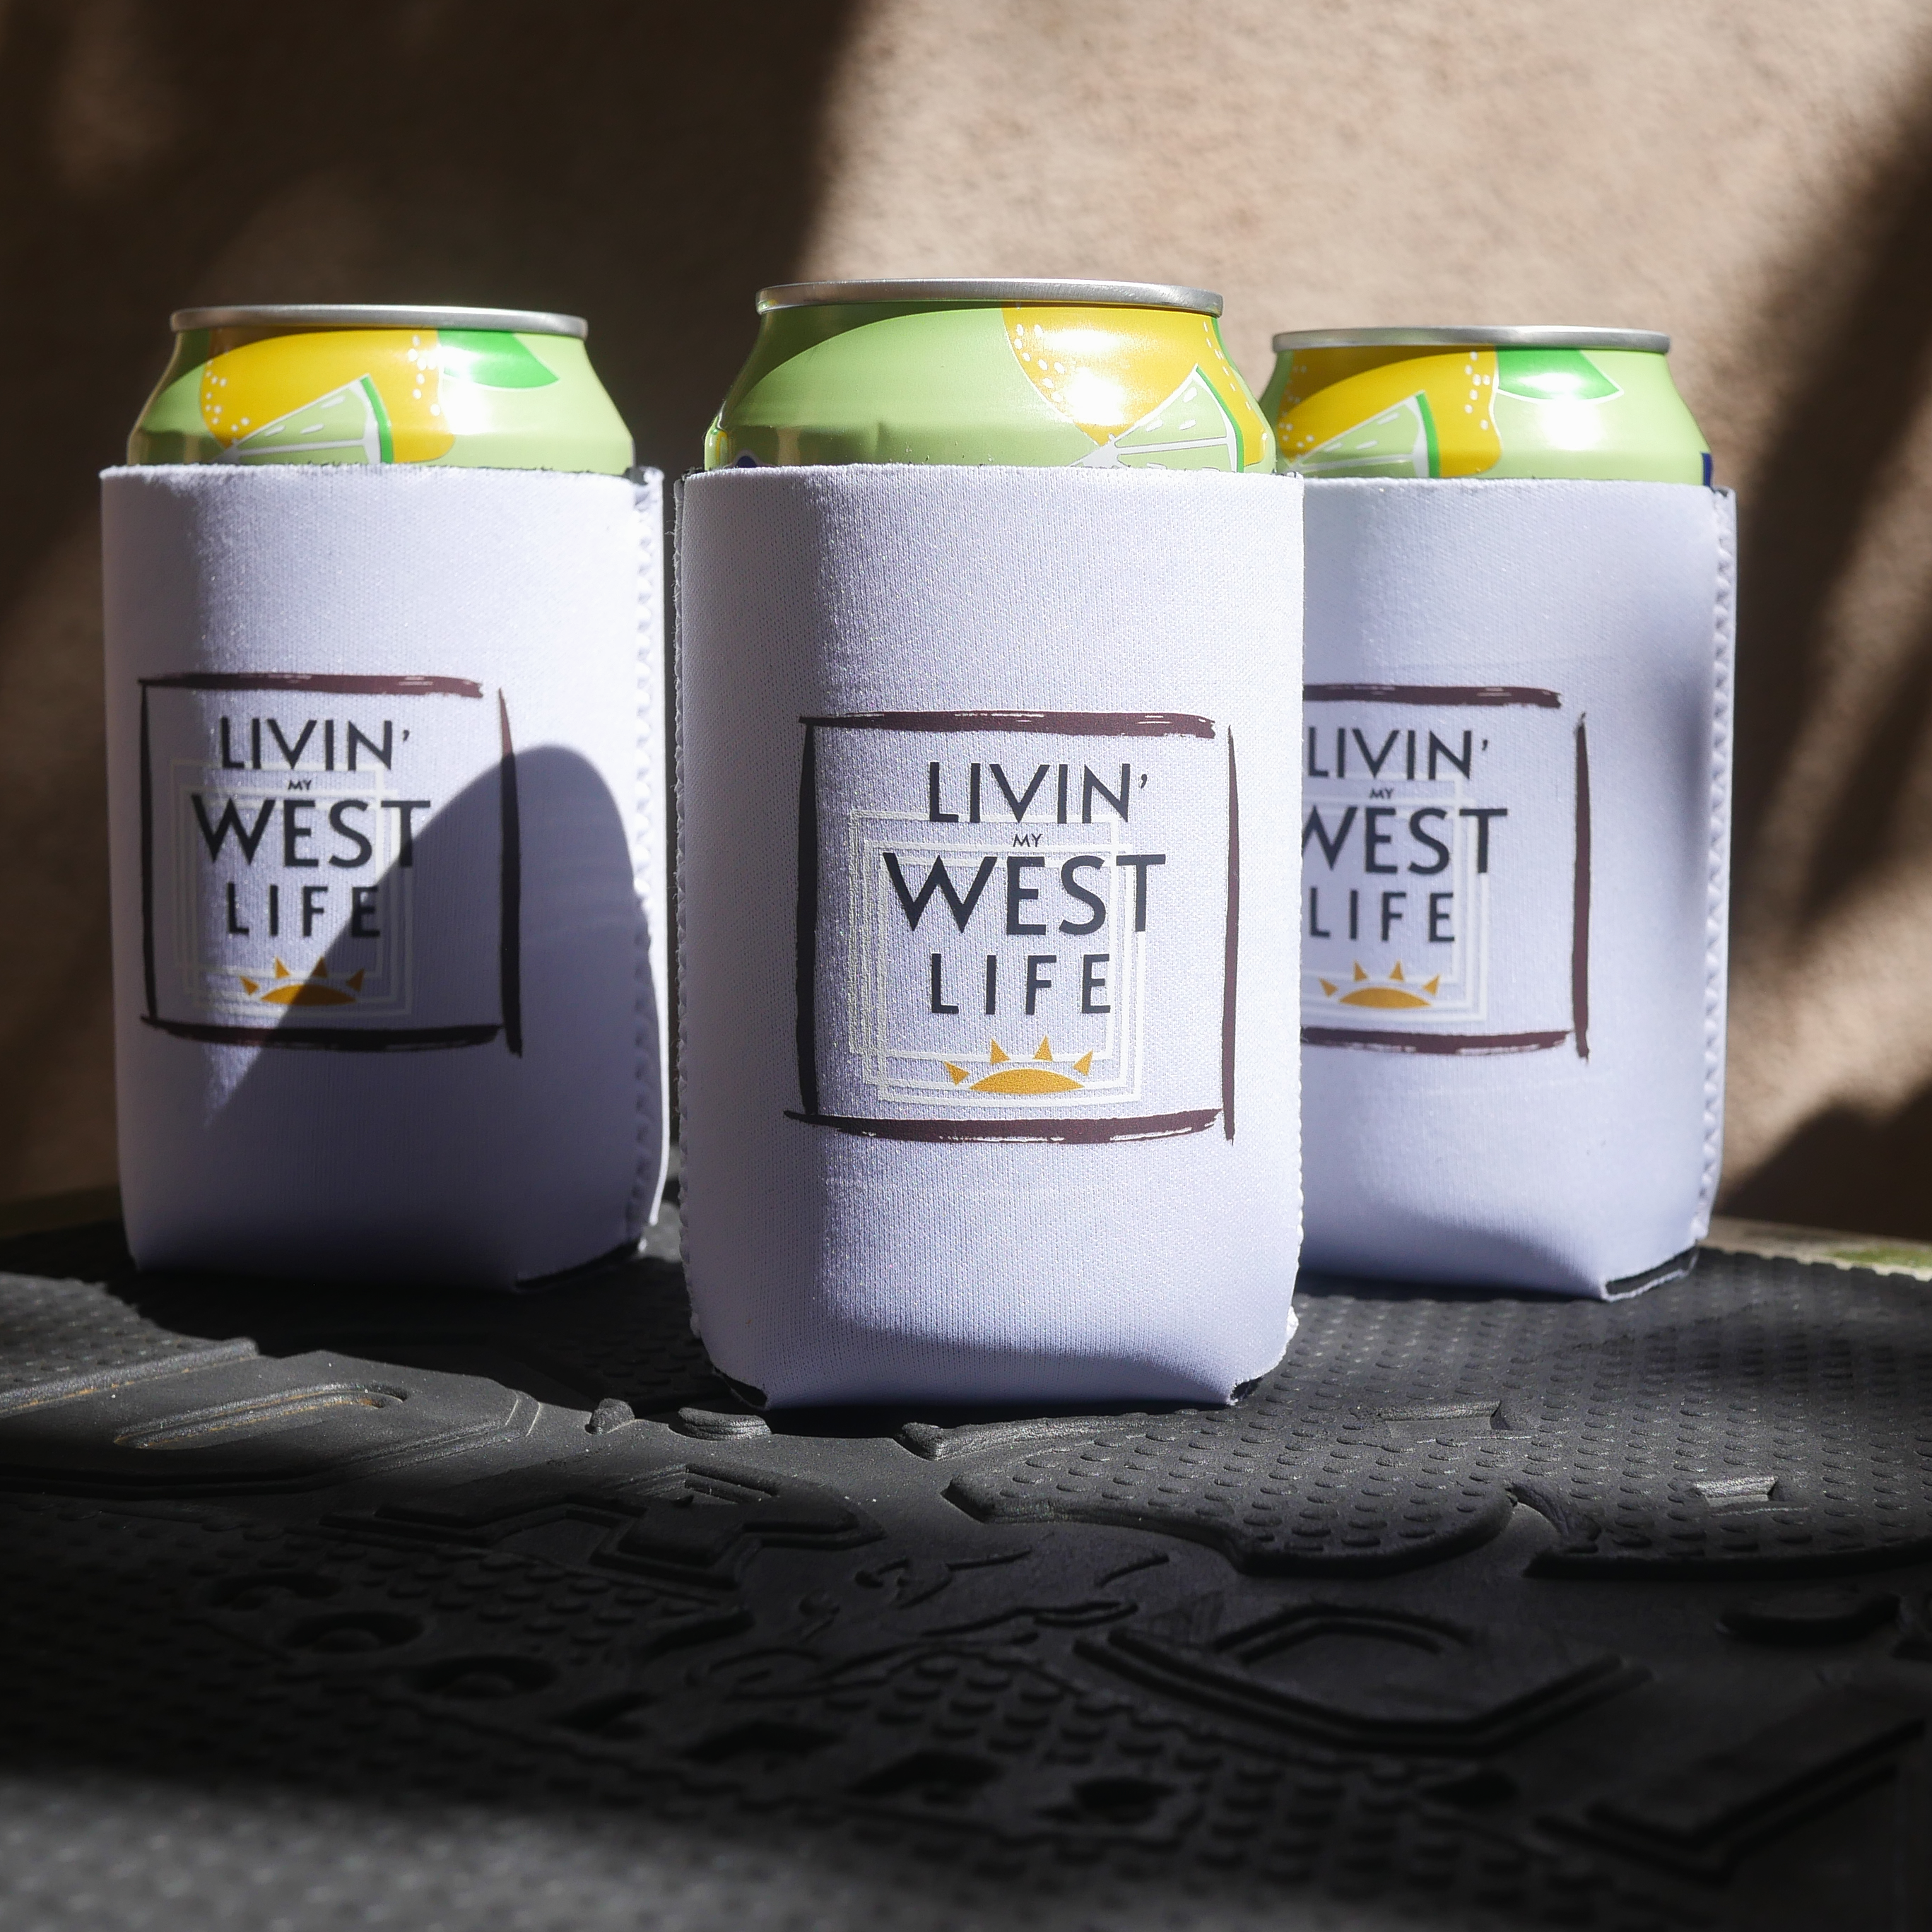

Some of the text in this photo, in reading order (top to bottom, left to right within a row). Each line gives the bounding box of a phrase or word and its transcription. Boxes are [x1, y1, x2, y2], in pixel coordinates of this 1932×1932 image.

[220, 716, 410, 772] LIVIN'
[1308, 726, 1488, 780] LIVIN'
[288, 779, 312, 791] MY
[929, 761, 1148, 824] LIVIN'
[1370, 788, 1394, 799] MY
[191, 793, 431, 868] WEST
[1013, 833, 1043, 848] MY
[227, 882, 381, 938] LIFE
[882, 852, 1167, 936] WEST
[1309, 886, 1456, 943] LIFE
[931, 953, 1112, 1015] LIFE
